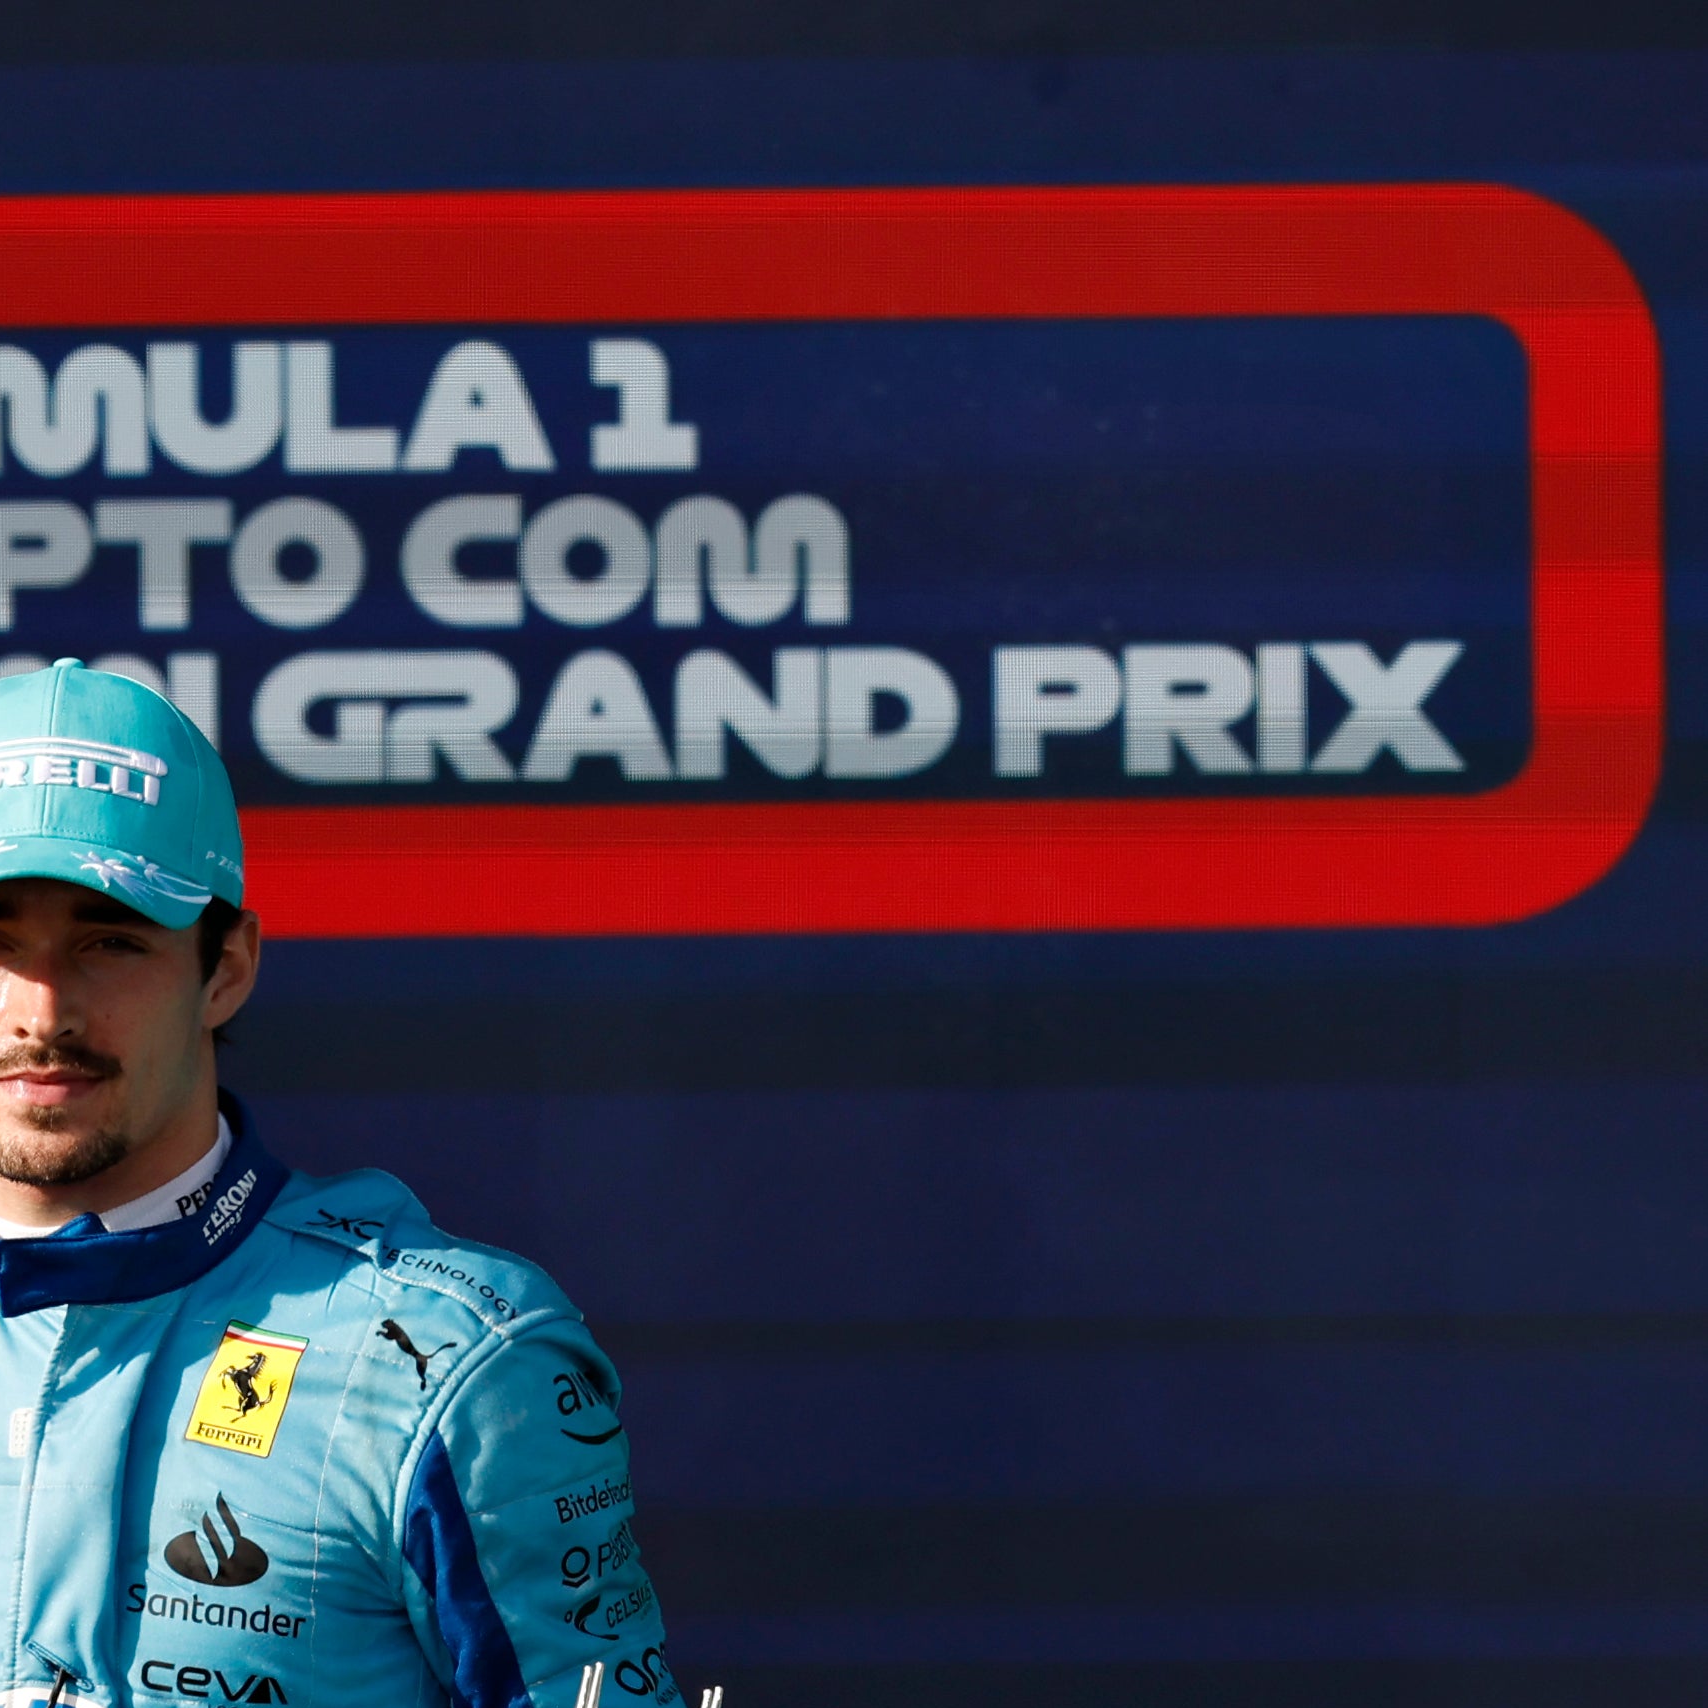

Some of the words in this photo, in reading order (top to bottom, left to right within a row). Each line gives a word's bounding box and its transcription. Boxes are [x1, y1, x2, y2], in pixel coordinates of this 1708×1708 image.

[589, 339, 697, 470] 1
[400, 495, 850, 628] COM
[252, 648, 959, 780] GRAND
[993, 643, 1464, 776] PRIX
[195, 1422, 264, 1452] Ferrari
[126, 1583, 307, 1638] Santander
